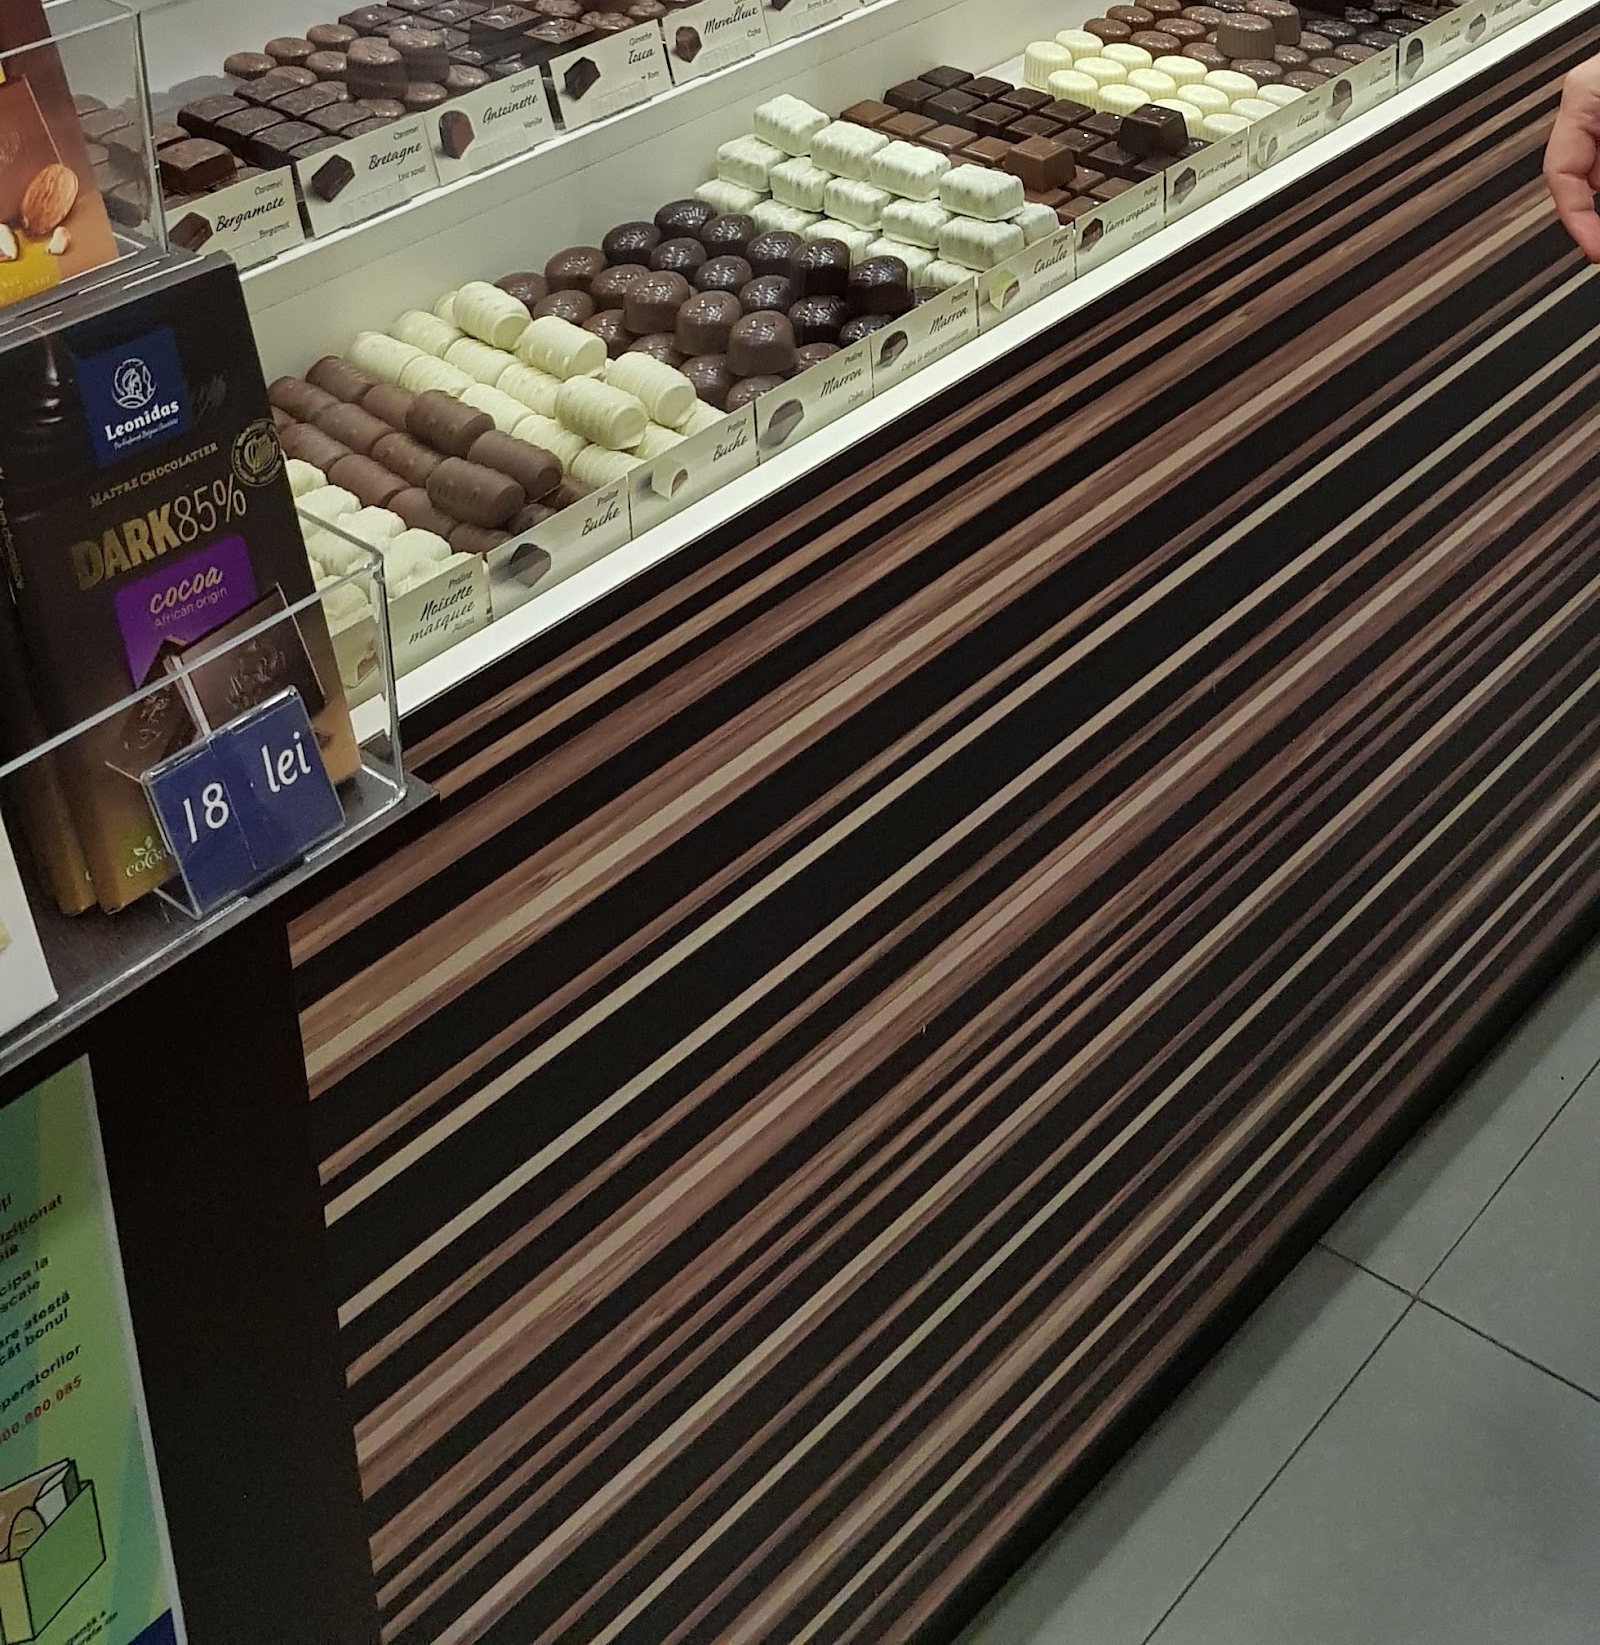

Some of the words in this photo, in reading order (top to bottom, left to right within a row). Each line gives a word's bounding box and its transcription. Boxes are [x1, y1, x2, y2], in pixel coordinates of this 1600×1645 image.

[704, 3, 758, 34] Merveilleux
[628, 47, 655, 65] Tosca
[483, 93, 539, 124] Antoinette
[368, 141, 422, 170] Bretagne
[254, 178, 284, 196] Caramel
[216, 196, 285, 232] Bergamote
[929, 305, 968, 335] Marron
[820, 366, 863, 398] Marron
[104, 399, 180, 442] Leonidas
[712, 427, 748, 462] Buche
[139, 441, 219, 487] CHOCOLATIER
[581, 501, 620, 537] Buche
[149, 565, 223, 616] cocoa
[448, 570, 473, 589] Praline
[195, 585, 228, 610] origin
[420, 585, 473, 622] Noisette
[182, 781, 230, 844] 18
[260, 730, 312, 794] lei
[34, 1255, 50, 1272] la
[25, 1306, 69, 1347] bonul
[0, 1343, 82, 1414] peratorilor
